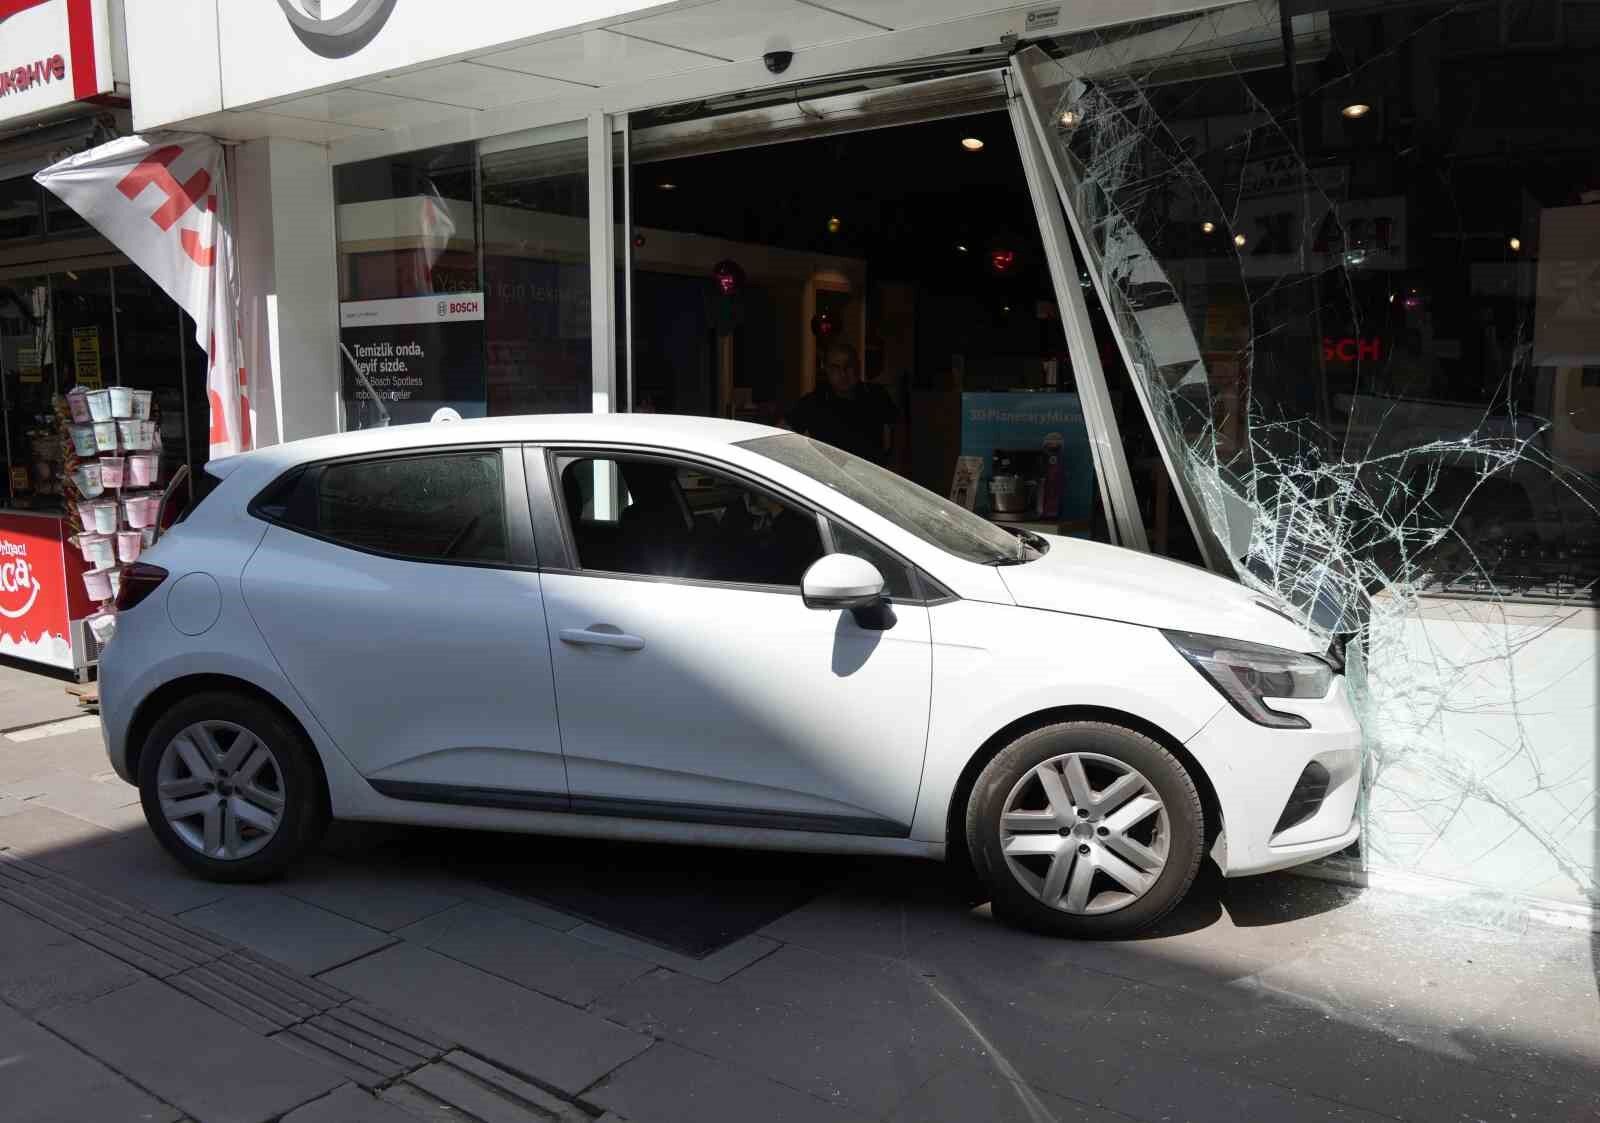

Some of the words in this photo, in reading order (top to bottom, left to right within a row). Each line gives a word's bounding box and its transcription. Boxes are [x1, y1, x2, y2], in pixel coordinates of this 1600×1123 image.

[450, 302, 478, 315] BOSCH
[353, 342, 393, 357] Temizlik
[395, 341, 424, 358] onda,
[353, 358, 378, 376] keyif
[379, 358, 408, 373] sizde.
